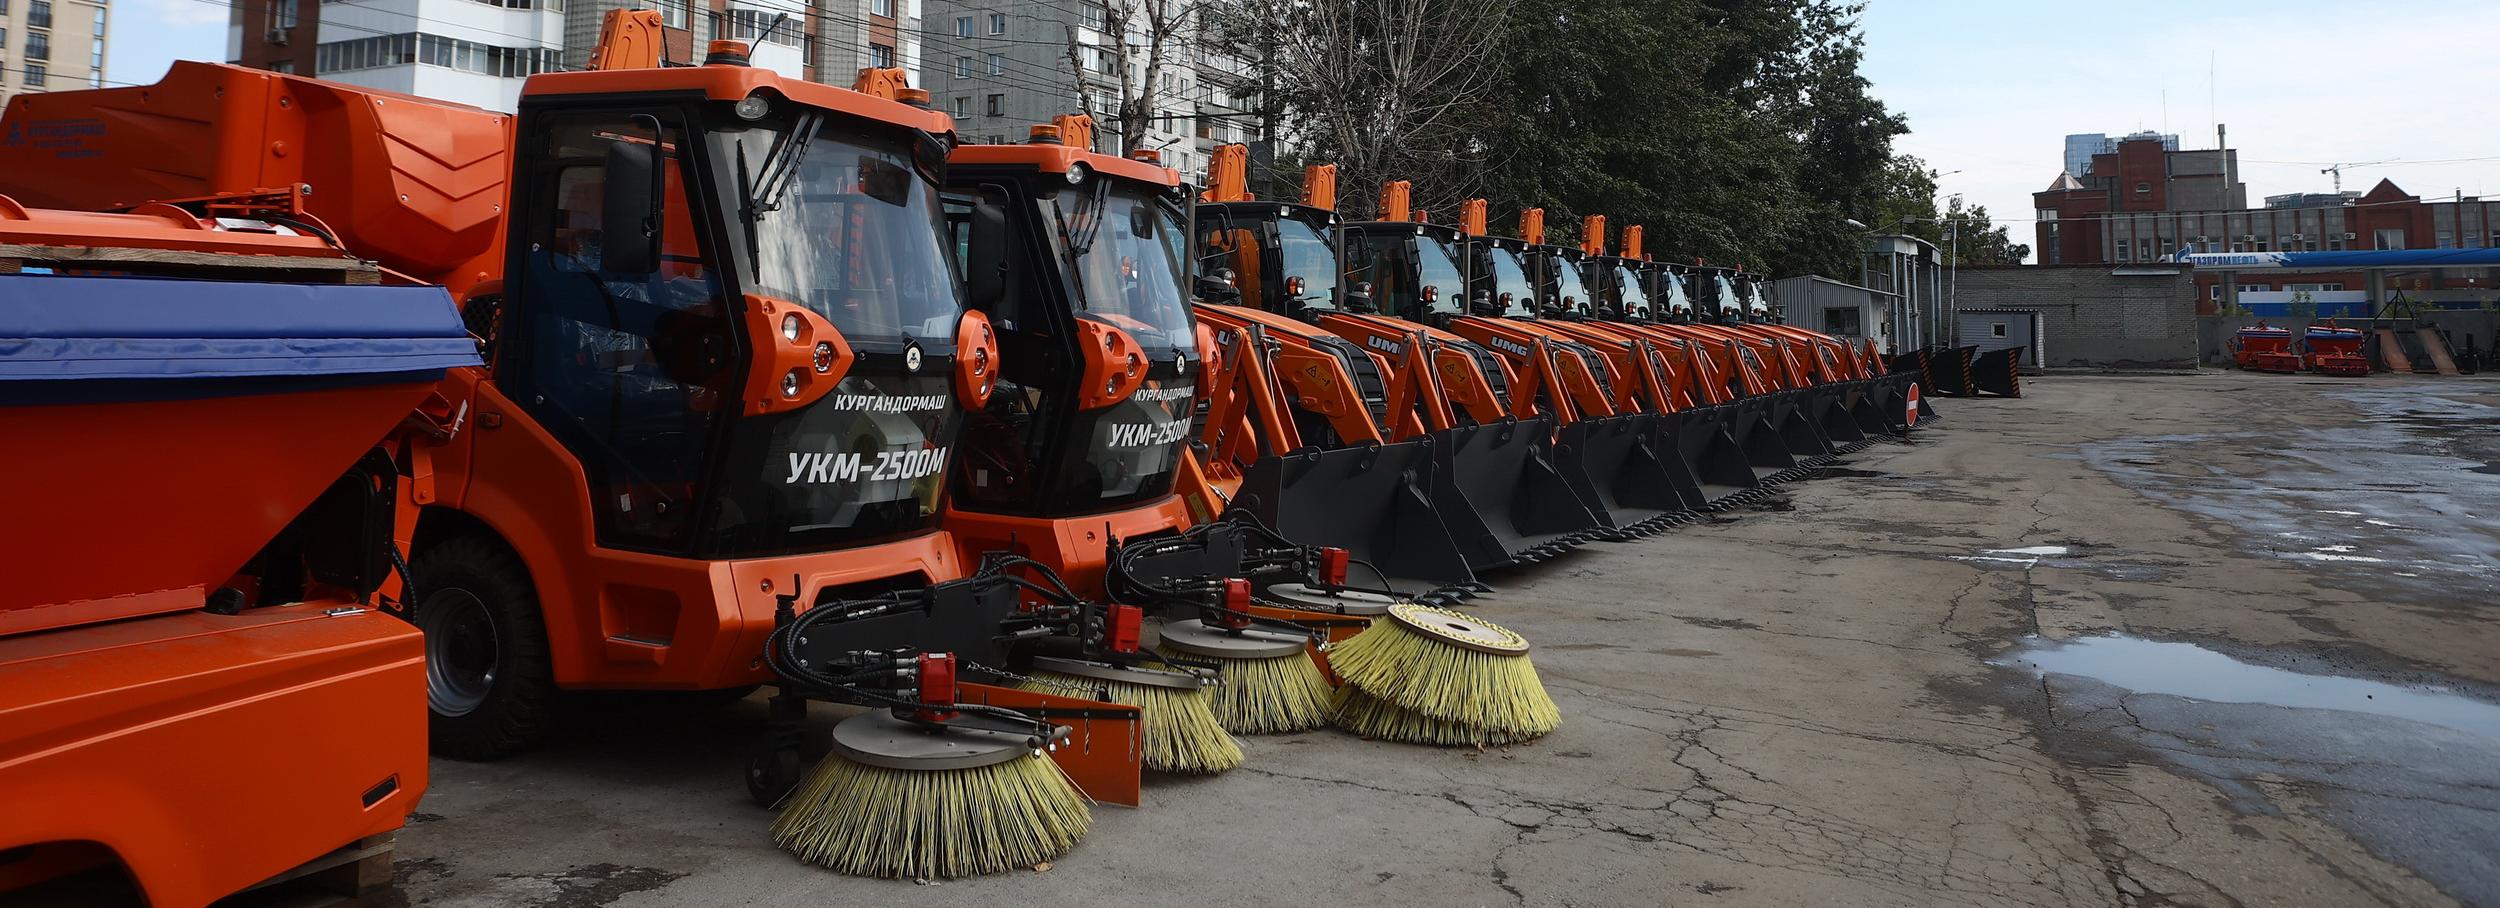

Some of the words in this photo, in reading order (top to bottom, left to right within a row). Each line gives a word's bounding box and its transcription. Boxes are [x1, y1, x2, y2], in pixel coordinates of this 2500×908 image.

[1368, 335, 1400, 354] UM
[1491, 336, 1528, 356] UMG
[1135, 385, 1194, 402] КУРГАНДОРМАШ
[834, 394, 947, 414] КУРГАНДОРМАШ
[1108, 416, 1192, 447] УКМ-2500М
[786, 447, 947, 484] УКМ-2500М
